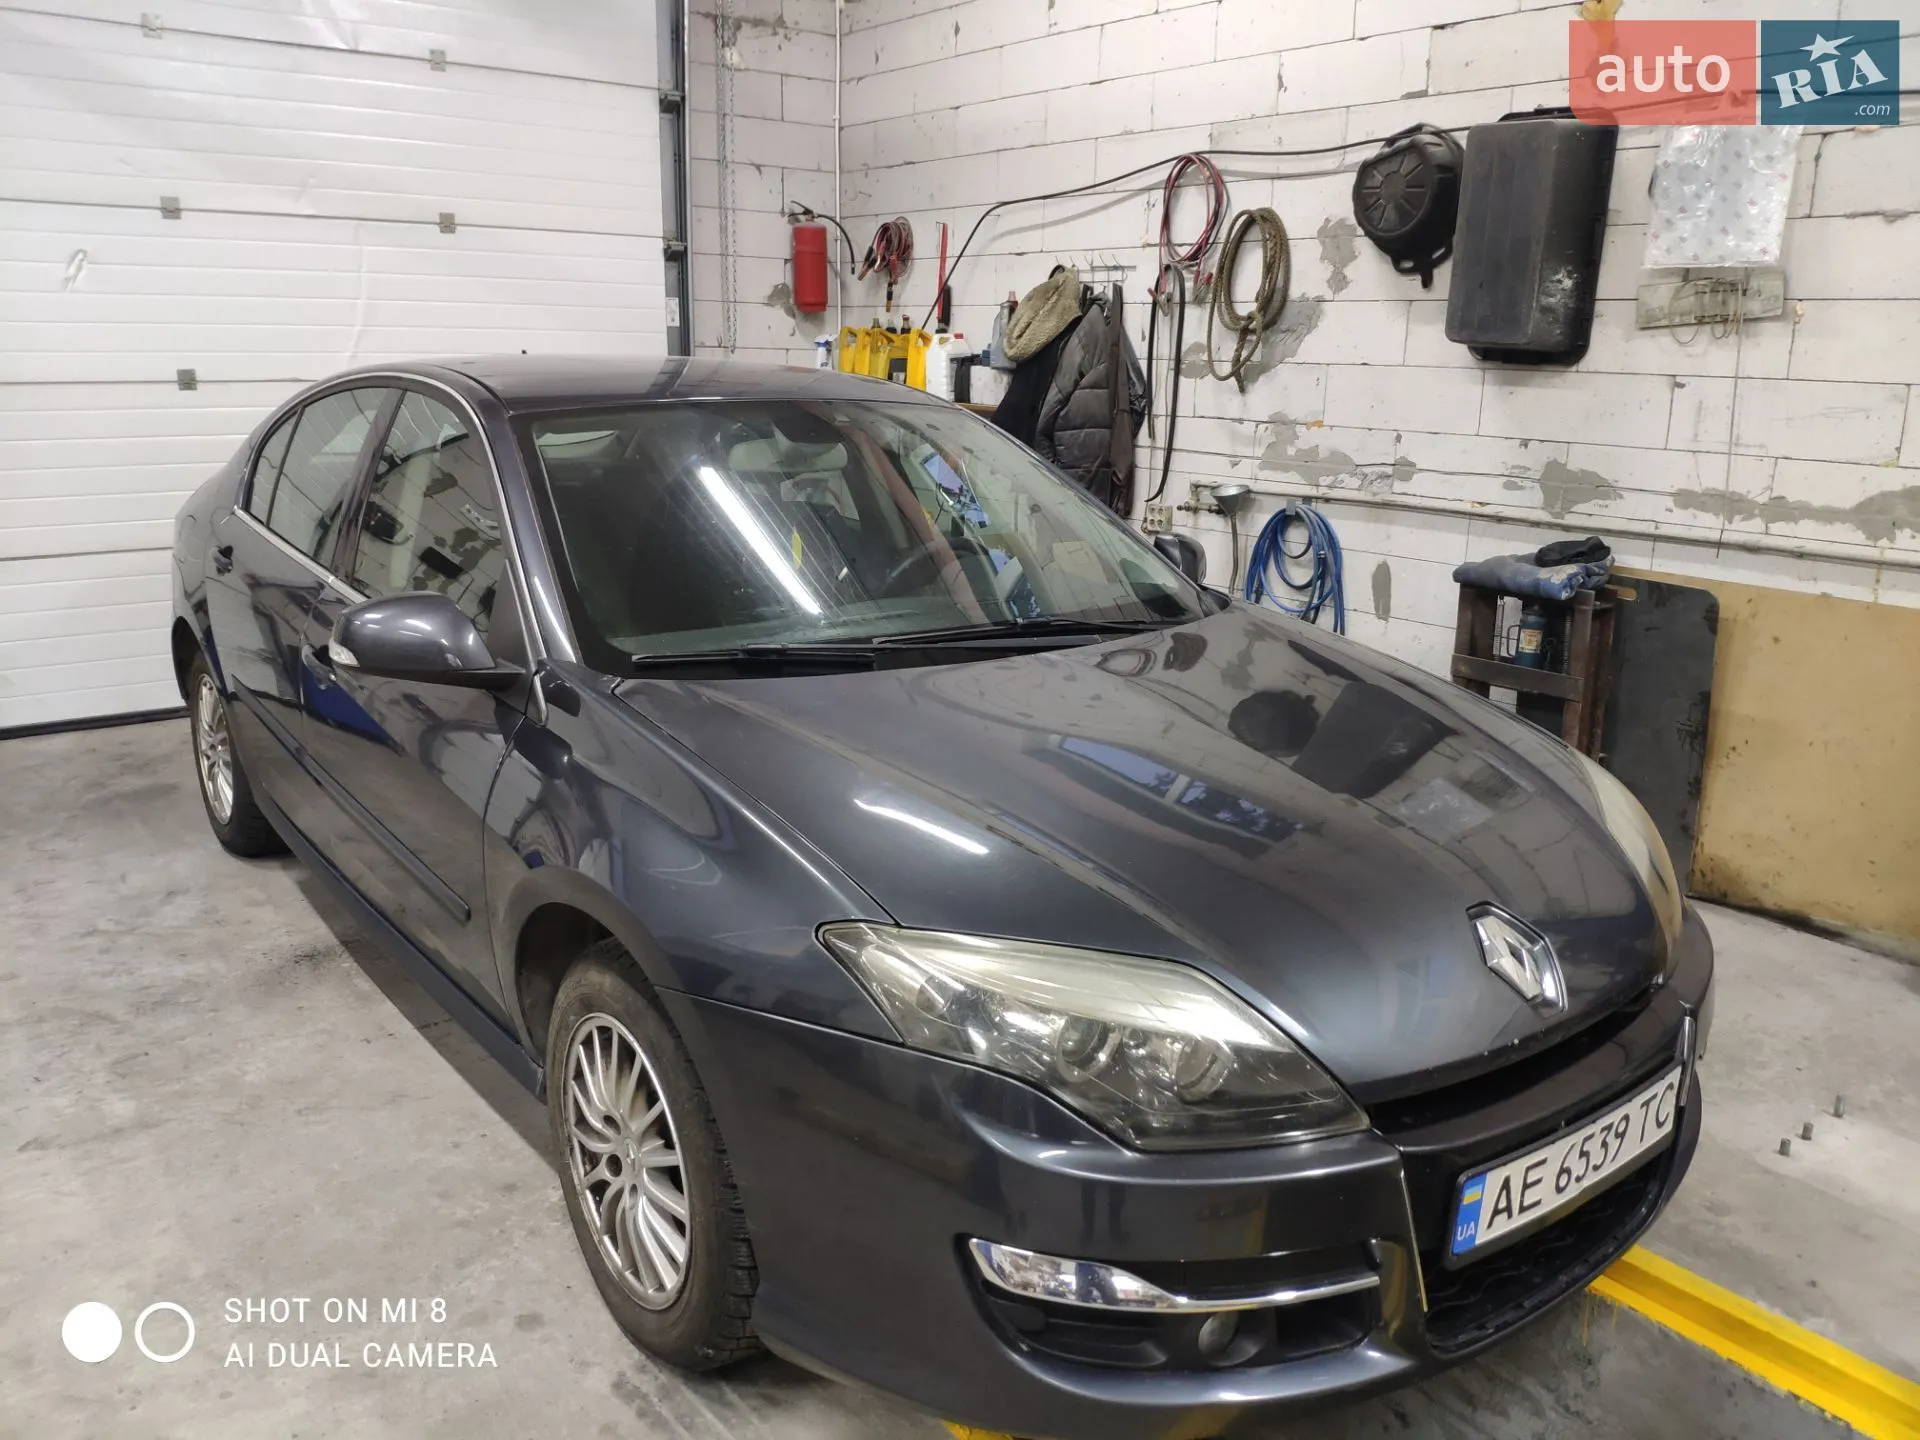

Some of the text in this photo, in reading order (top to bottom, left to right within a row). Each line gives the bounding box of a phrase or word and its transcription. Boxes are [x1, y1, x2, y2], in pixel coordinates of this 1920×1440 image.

[1486, 1081, 1674, 1230] AE 6539 TC
[1457, 1220, 1475, 1241] UA
